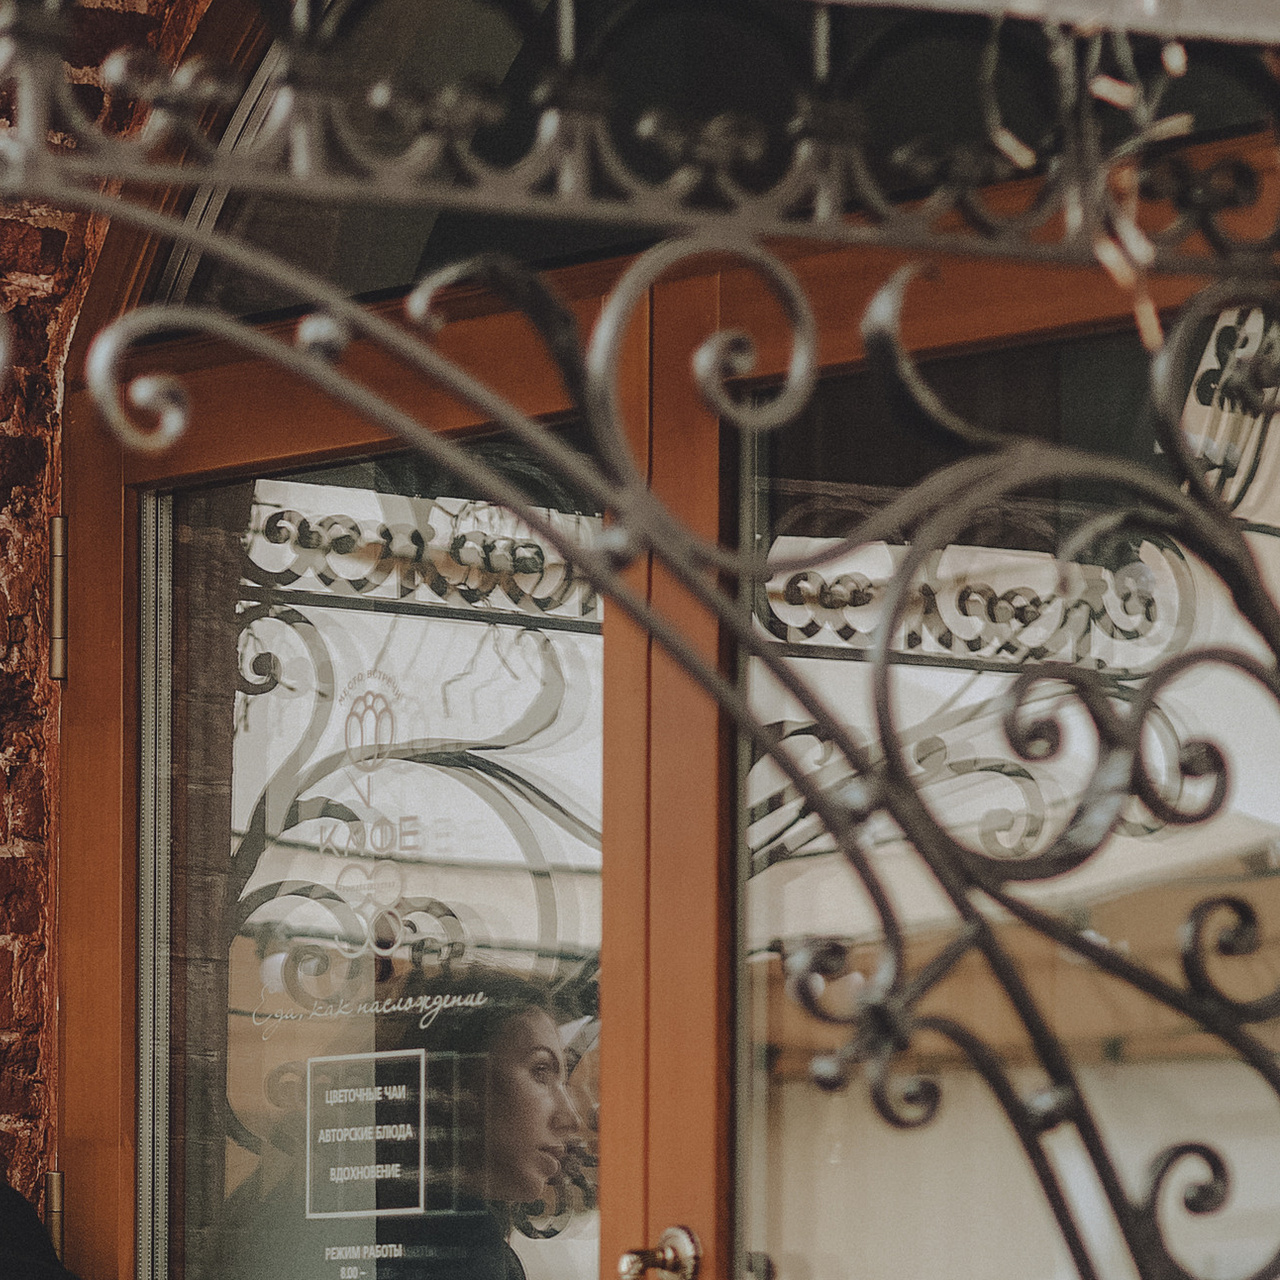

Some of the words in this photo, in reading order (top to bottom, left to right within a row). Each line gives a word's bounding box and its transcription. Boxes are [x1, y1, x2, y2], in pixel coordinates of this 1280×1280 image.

[339, 672, 364, 706] МЕСТО
[308, 1000, 353, 1020] как
[325, 1086, 382, 1106] ЦВЕТОЧНЫЕ
[318, 1126, 373, 1143] АВТОРСКИЕ
[375, 1123, 413, 1141] БЛЮДА
[330, 1163, 401, 1182] ВДОХНОВЕНИЕ
[325, 1246, 361, 1260] РЕЖИМ
[363, 1244, 403, 1259] РАБОТЫ
